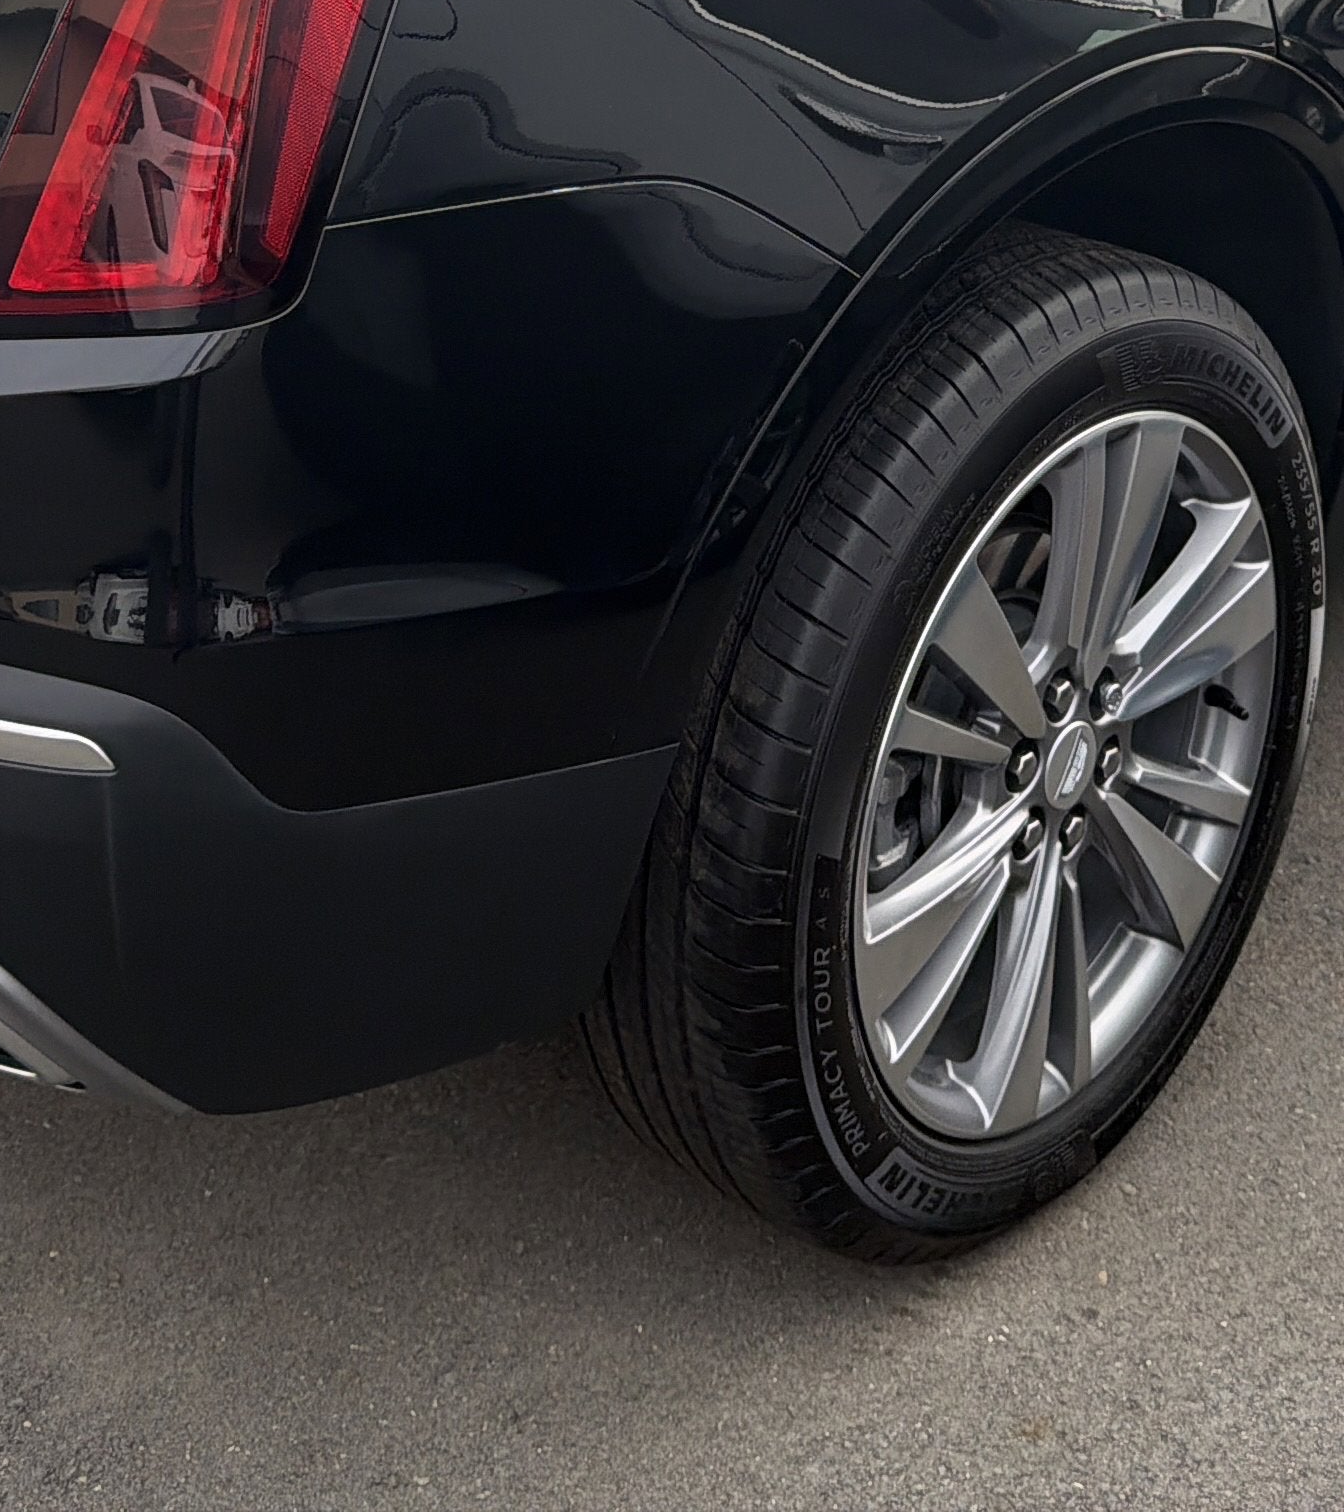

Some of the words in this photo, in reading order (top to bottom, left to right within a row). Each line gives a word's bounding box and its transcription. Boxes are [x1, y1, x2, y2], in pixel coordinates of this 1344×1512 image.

[1170, 344, 1287, 438] MICHELIN
[1291, 452, 1318, 531] 235/55
[1310, 537, 1320, 555] R
[1311, 566, 1322, 596] 20
[818, 887, 831, 899] S
[815, 917, 828, 931] A
[814, 946, 834, 1036] TOUR
[819, 1048, 871, 1159] PRIMACY
